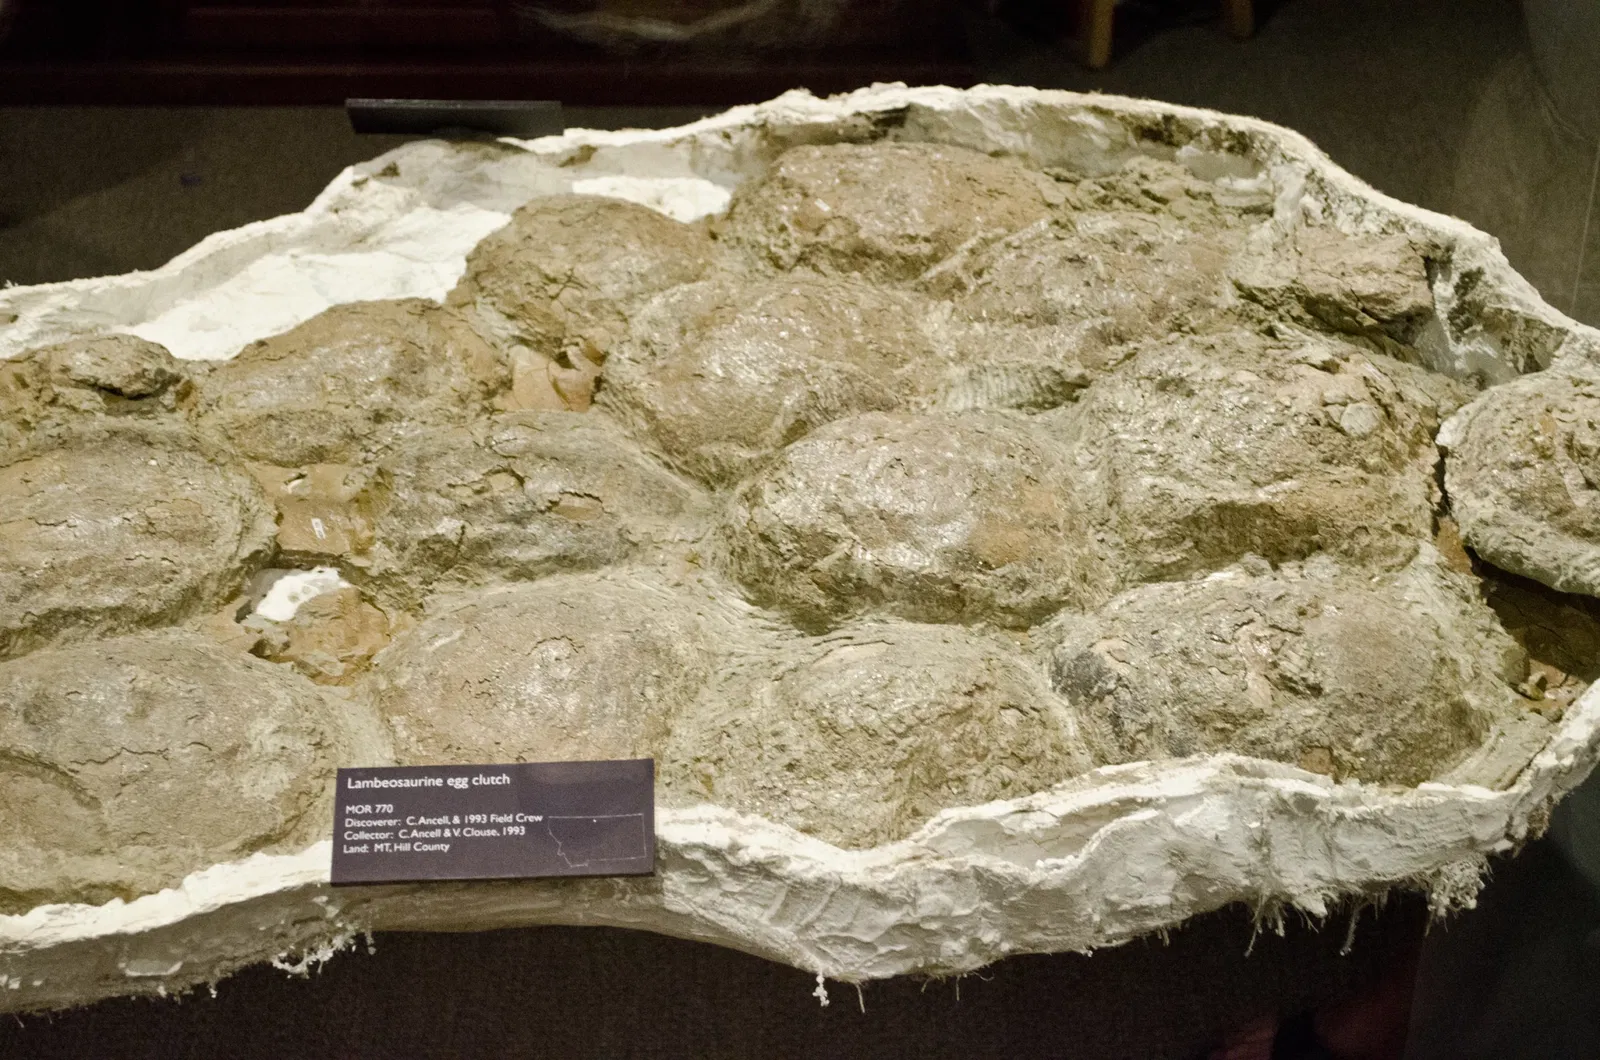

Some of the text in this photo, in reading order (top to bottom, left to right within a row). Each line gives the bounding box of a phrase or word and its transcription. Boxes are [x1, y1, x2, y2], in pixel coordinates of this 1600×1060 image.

[347, 774, 510, 789] Lambeosaurine egg clutch
[345, 804, 394, 814] MOR 770
[344, 818, 401, 828] Discoverer:
[452, 814, 461, 825] &
[464, 814, 487, 825] 1993
[490, 813, 513, 824] Field
[515, 812, 543, 823] Crew
[343, 830, 394, 841] Collector:
[443, 828, 451, 838] &
[502, 825, 526, 836] 1993
[343, 844, 369, 854] Land:
[393, 842, 411, 852] Hill
[413, 841, 450, 853] County
